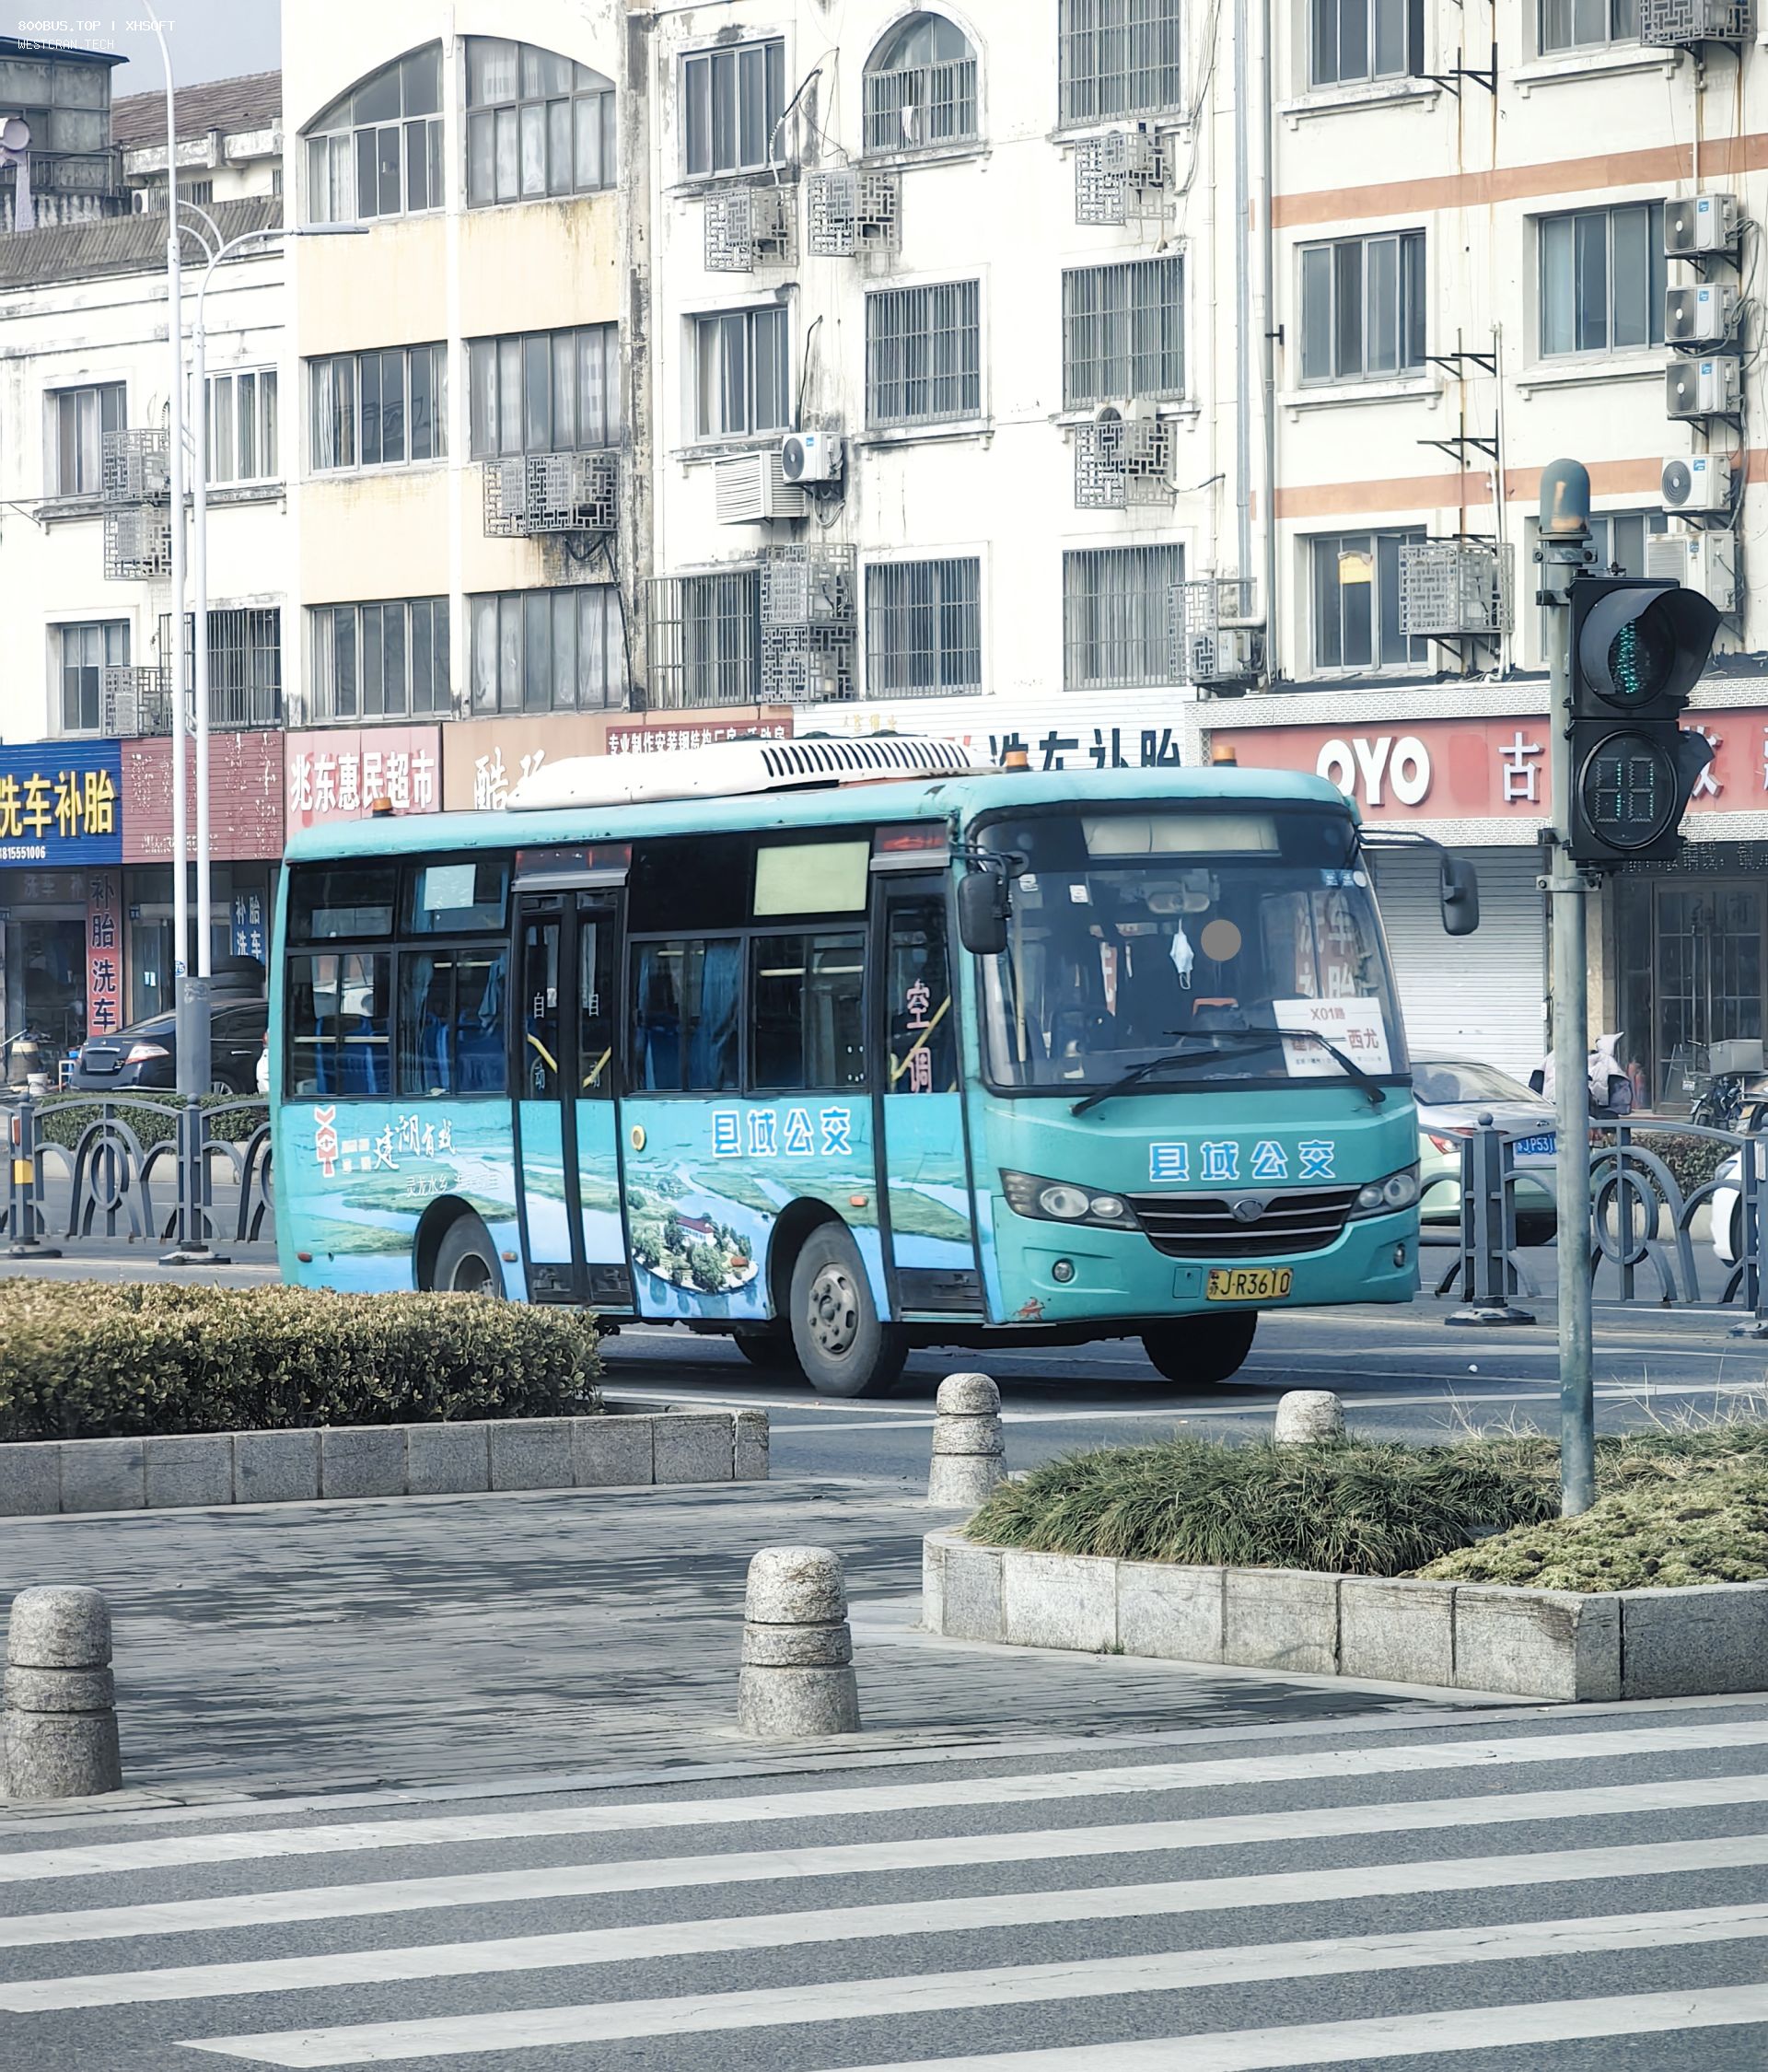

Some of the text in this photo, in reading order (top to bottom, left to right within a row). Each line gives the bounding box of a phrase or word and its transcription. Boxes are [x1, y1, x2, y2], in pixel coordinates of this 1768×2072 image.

[290, 750, 435, 813] 兆东惠民超市
[1316, 736, 1430, 805] OYO
[89, 874, 117, 1033] 补胎洗车
[712, 1106, 852, 1158] 县域公交
[1149, 1139, 1337, 1182] 县域公交
